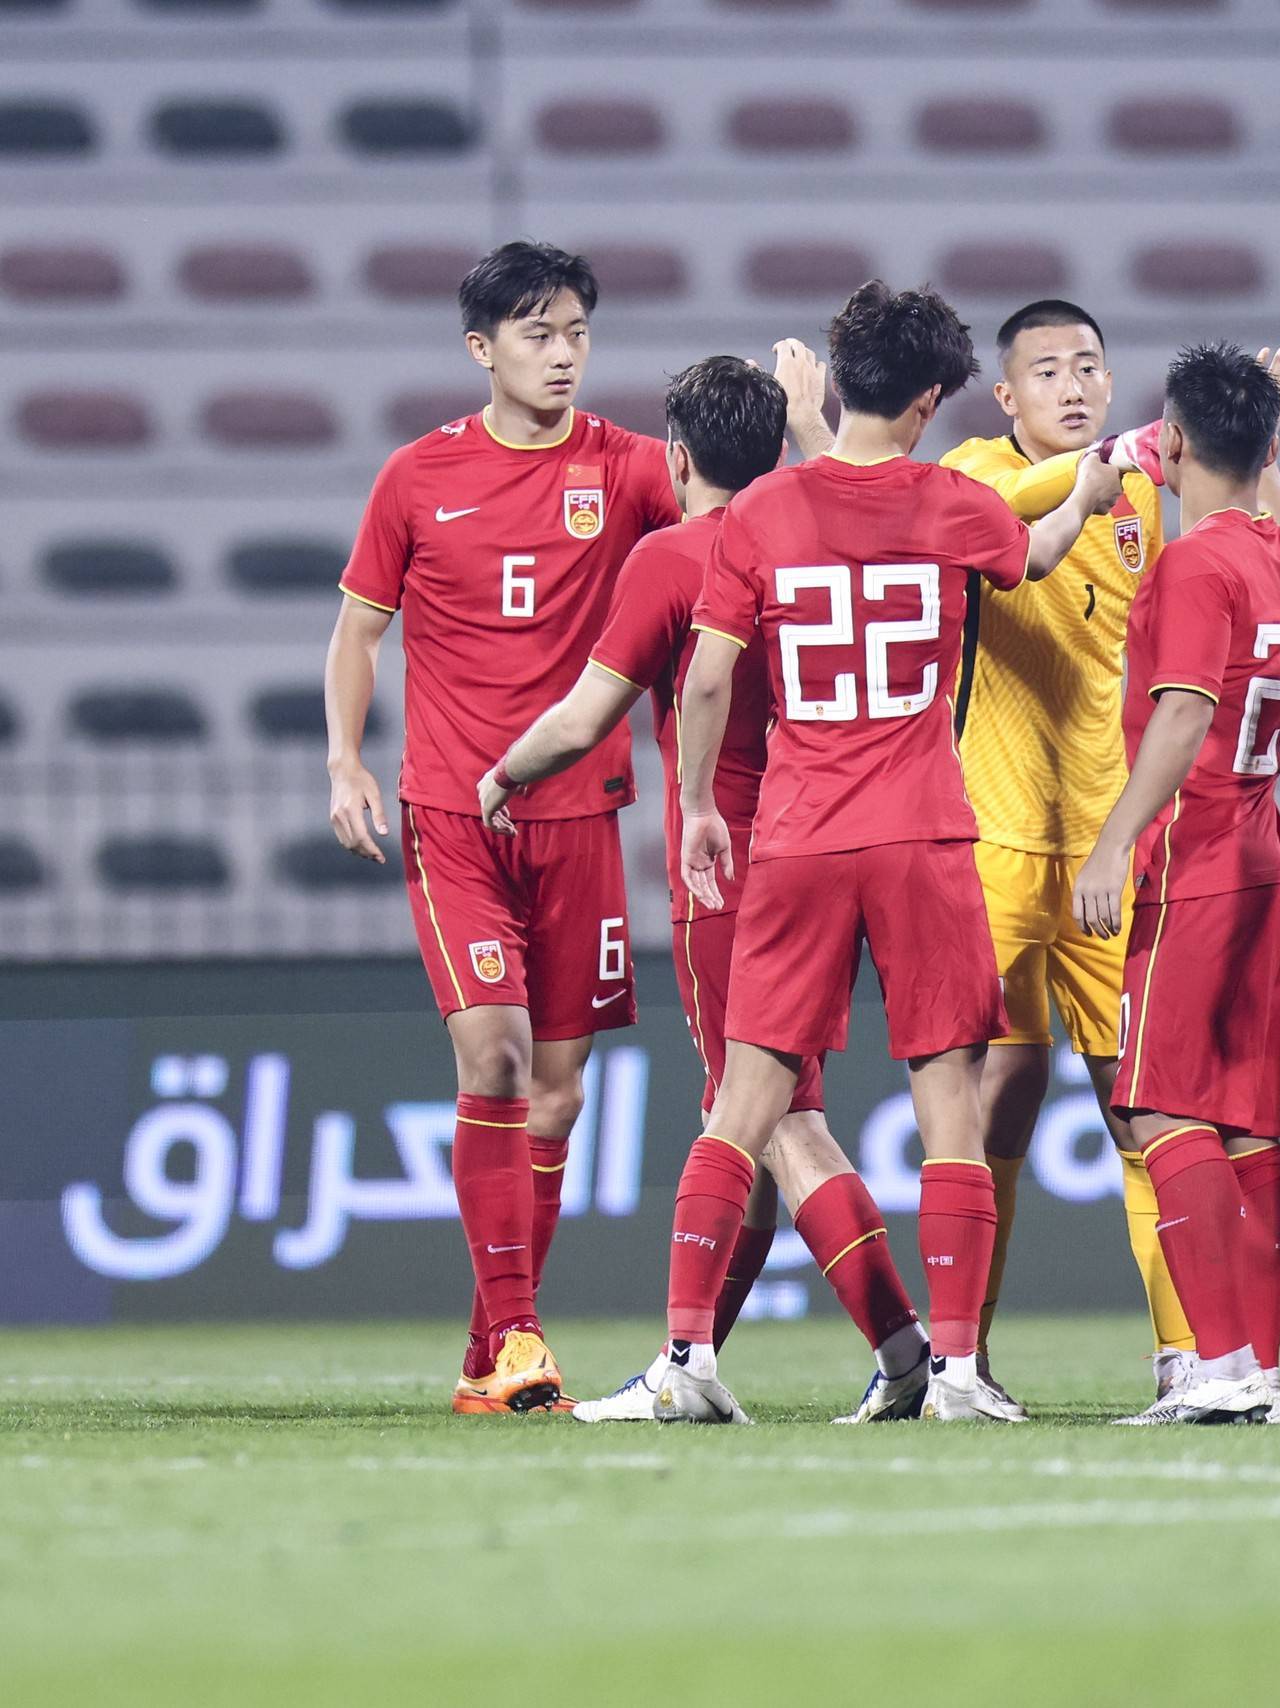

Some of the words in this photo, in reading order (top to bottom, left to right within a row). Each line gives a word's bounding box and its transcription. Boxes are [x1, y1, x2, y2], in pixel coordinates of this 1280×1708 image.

[569, 494, 599, 505] CFA
[1117, 523, 1137, 536] CFA
[501, 555, 536, 618] 6
[1083, 583, 1096, 622] 1
[774, 563, 940, 722] 22
[474, 944, 498, 955] CFA
[599, 917, 625, 981] 6
[673, 1232, 717, 1250] CFA
[927, 1255, 954, 1266] 中国
